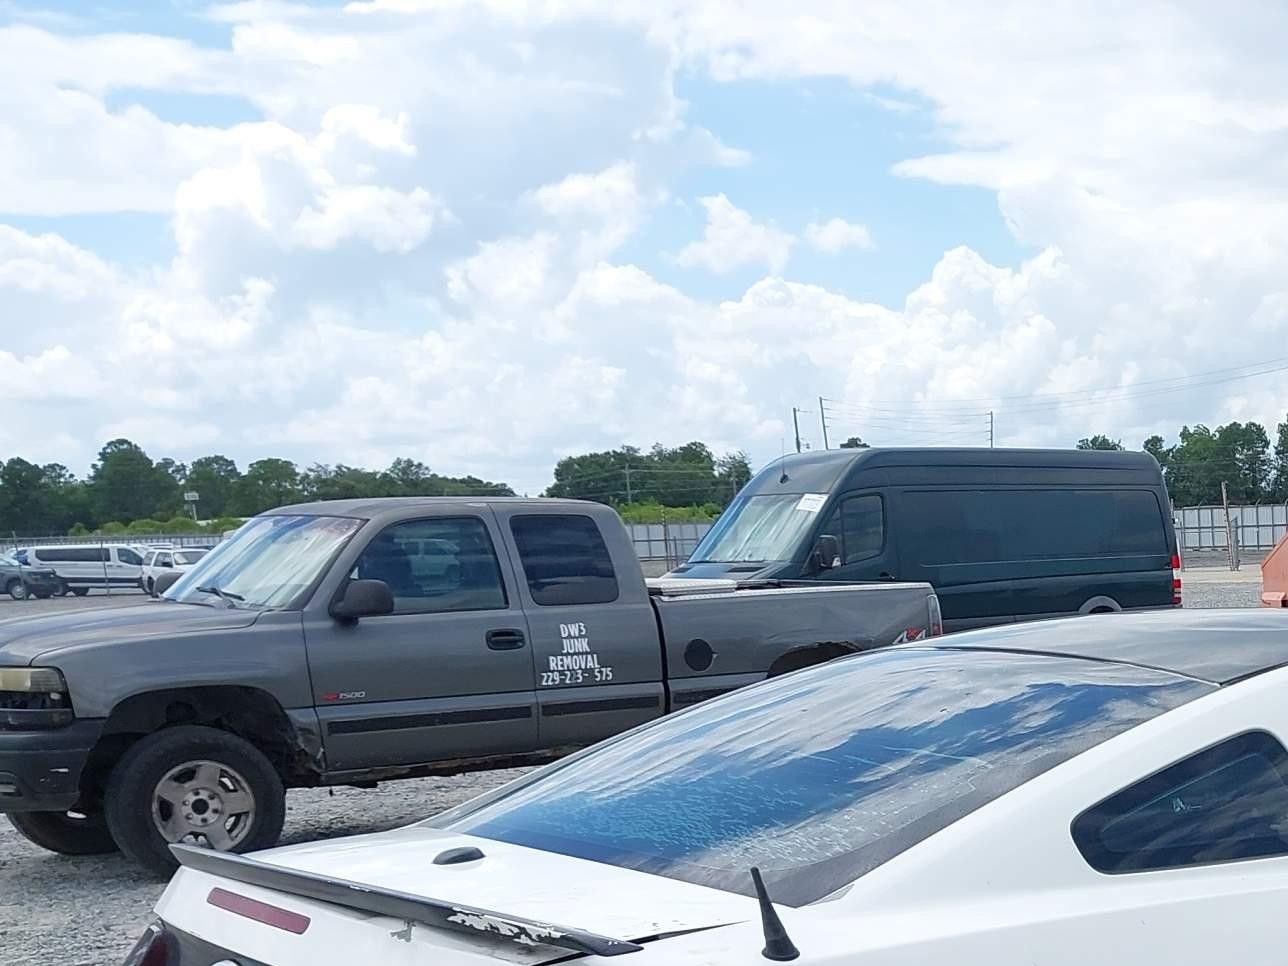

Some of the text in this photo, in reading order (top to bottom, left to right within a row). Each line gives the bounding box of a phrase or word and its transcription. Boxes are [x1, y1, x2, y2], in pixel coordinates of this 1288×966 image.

[560, 623, 587, 637] DW3
[562, 638, 590, 653] JUNK
[549, 654, 600, 671] REMOVAL
